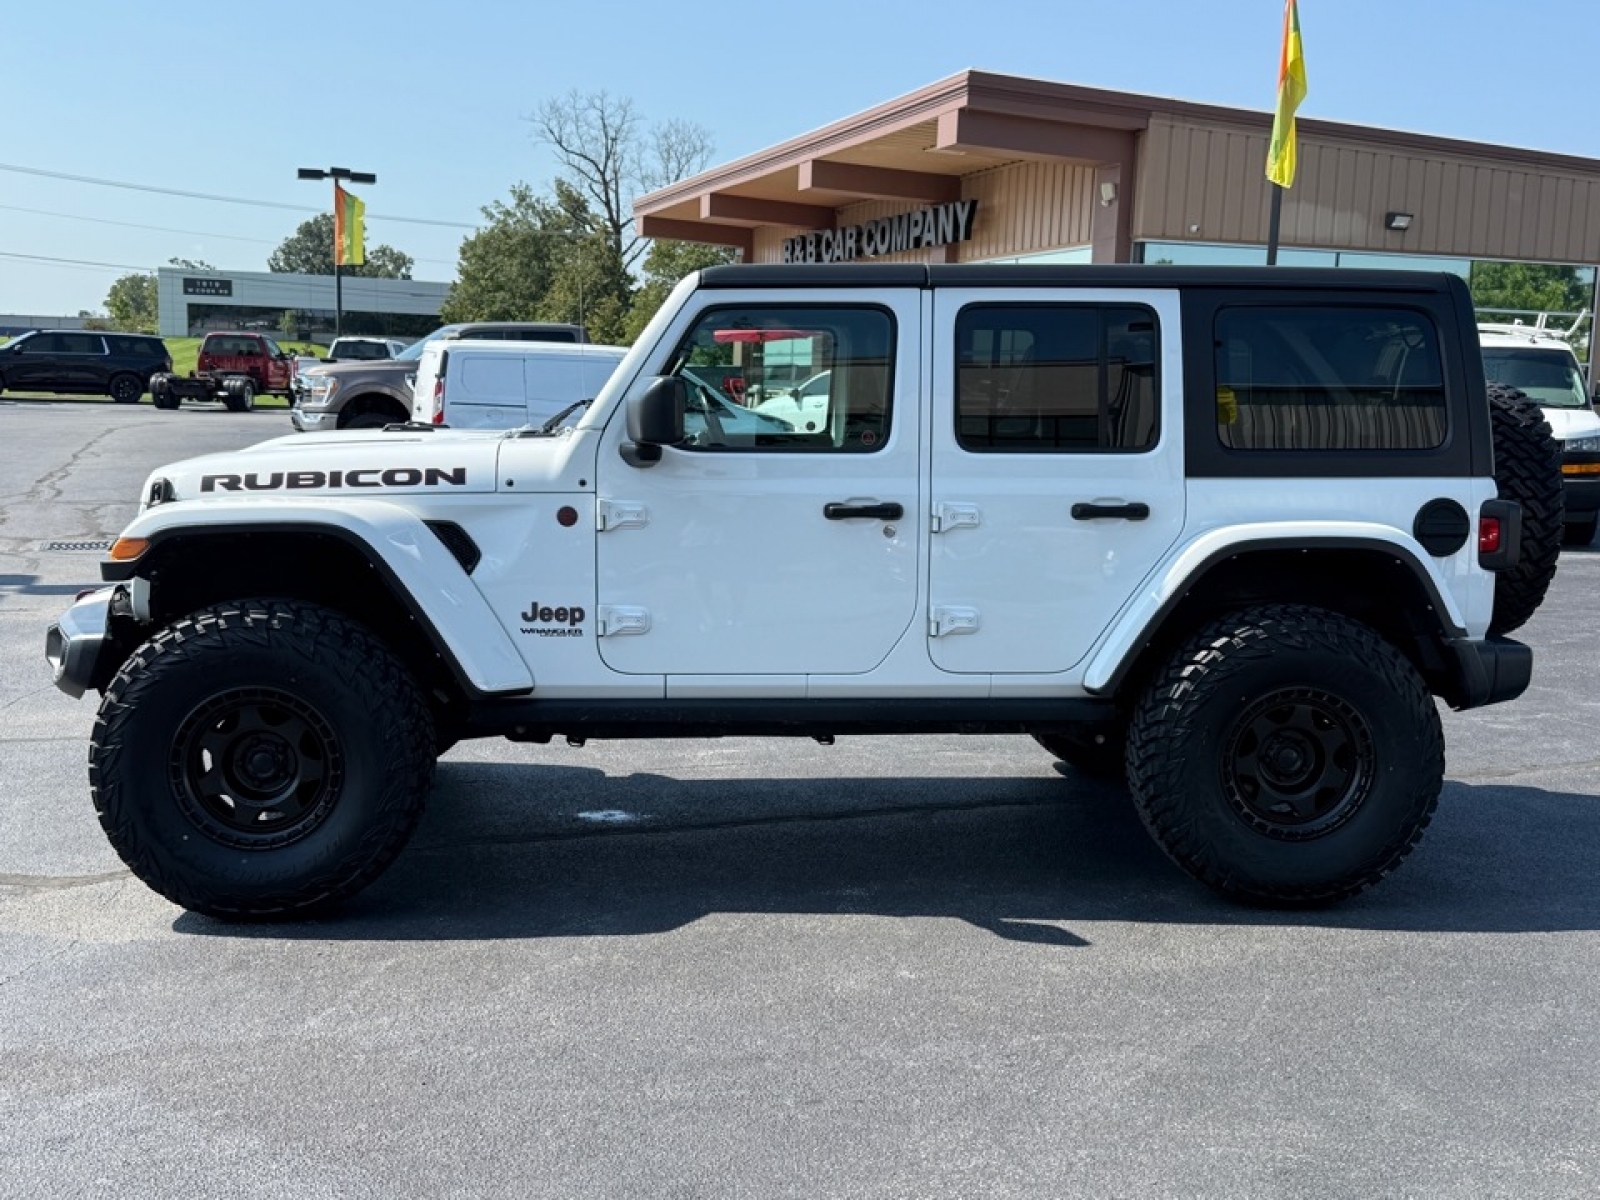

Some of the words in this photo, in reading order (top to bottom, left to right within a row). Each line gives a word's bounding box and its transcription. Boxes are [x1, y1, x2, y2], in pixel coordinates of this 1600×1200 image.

[821, 226, 860, 263] CAR
[862, 200, 977, 257] COMPANY
[200, 467, 466, 492] RUBICON
[521, 601, 585, 627] Jeep
